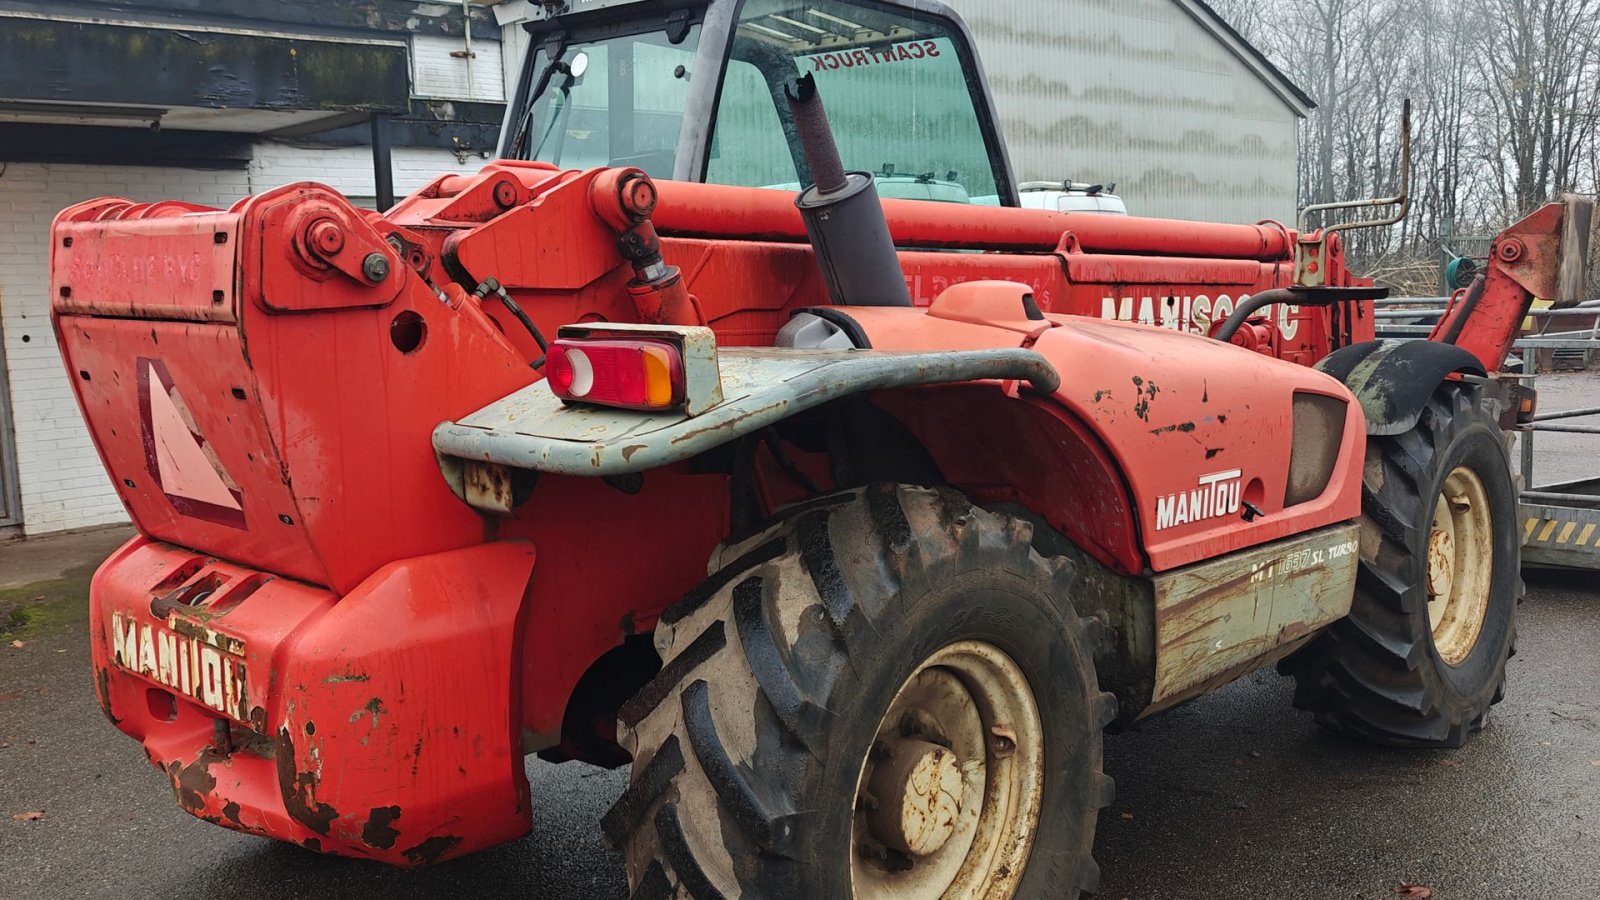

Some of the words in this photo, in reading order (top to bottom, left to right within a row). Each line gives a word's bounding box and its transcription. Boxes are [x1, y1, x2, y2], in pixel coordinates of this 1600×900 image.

[1156, 468, 1242, 531] MANITOU
[1311, 550, 1325, 566] SL
[1328, 540, 1358, 560] TURBO
[112, 610, 248, 722] MANITOU
